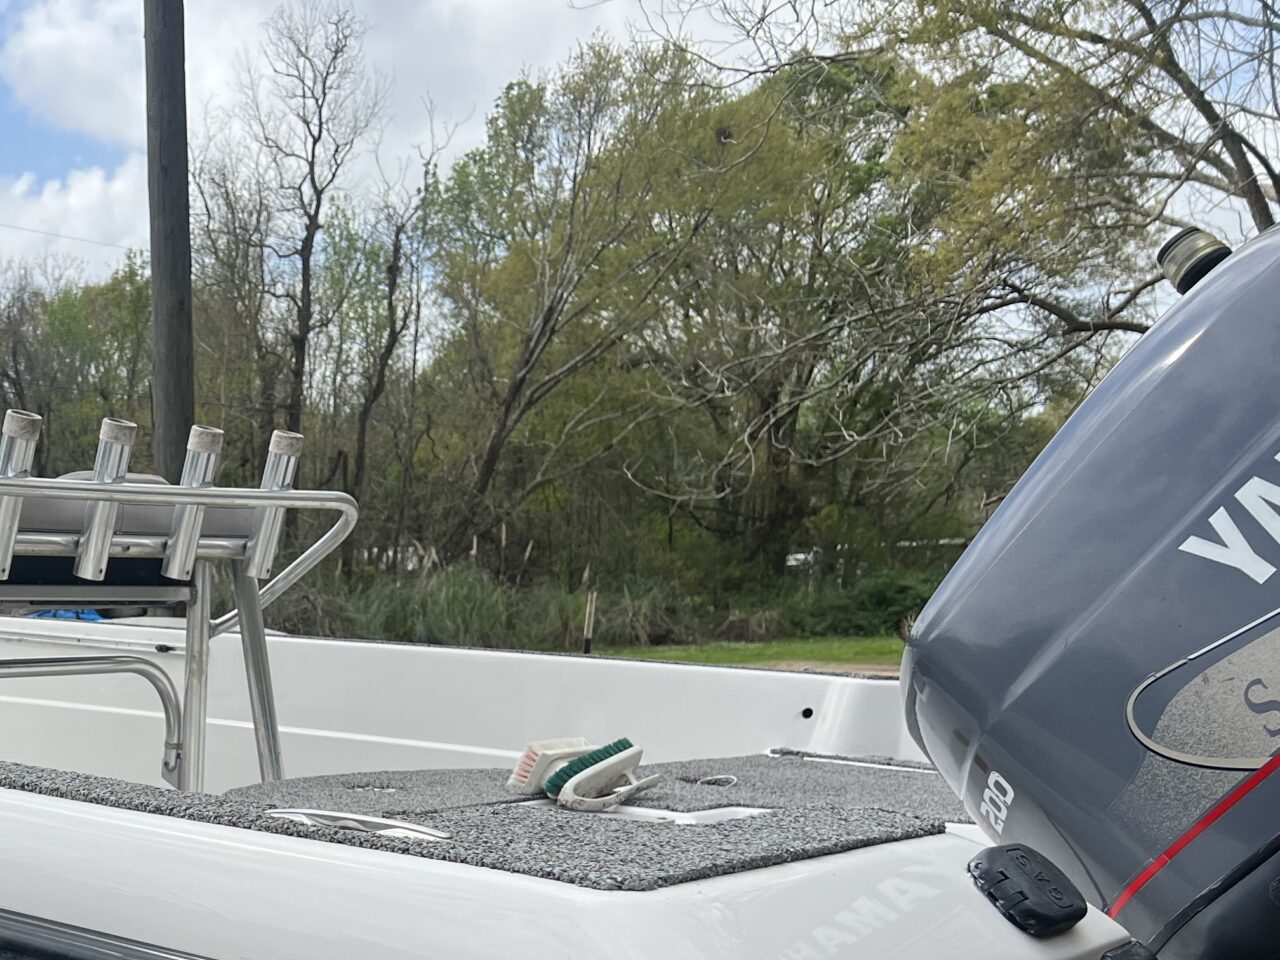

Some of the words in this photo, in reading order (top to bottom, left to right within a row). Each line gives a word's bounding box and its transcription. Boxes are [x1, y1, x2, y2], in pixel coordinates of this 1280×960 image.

[1178, 452, 1280, 584] YA
[980, 770, 1015, 835] 200
[1015, 854, 1064, 901] GAS
